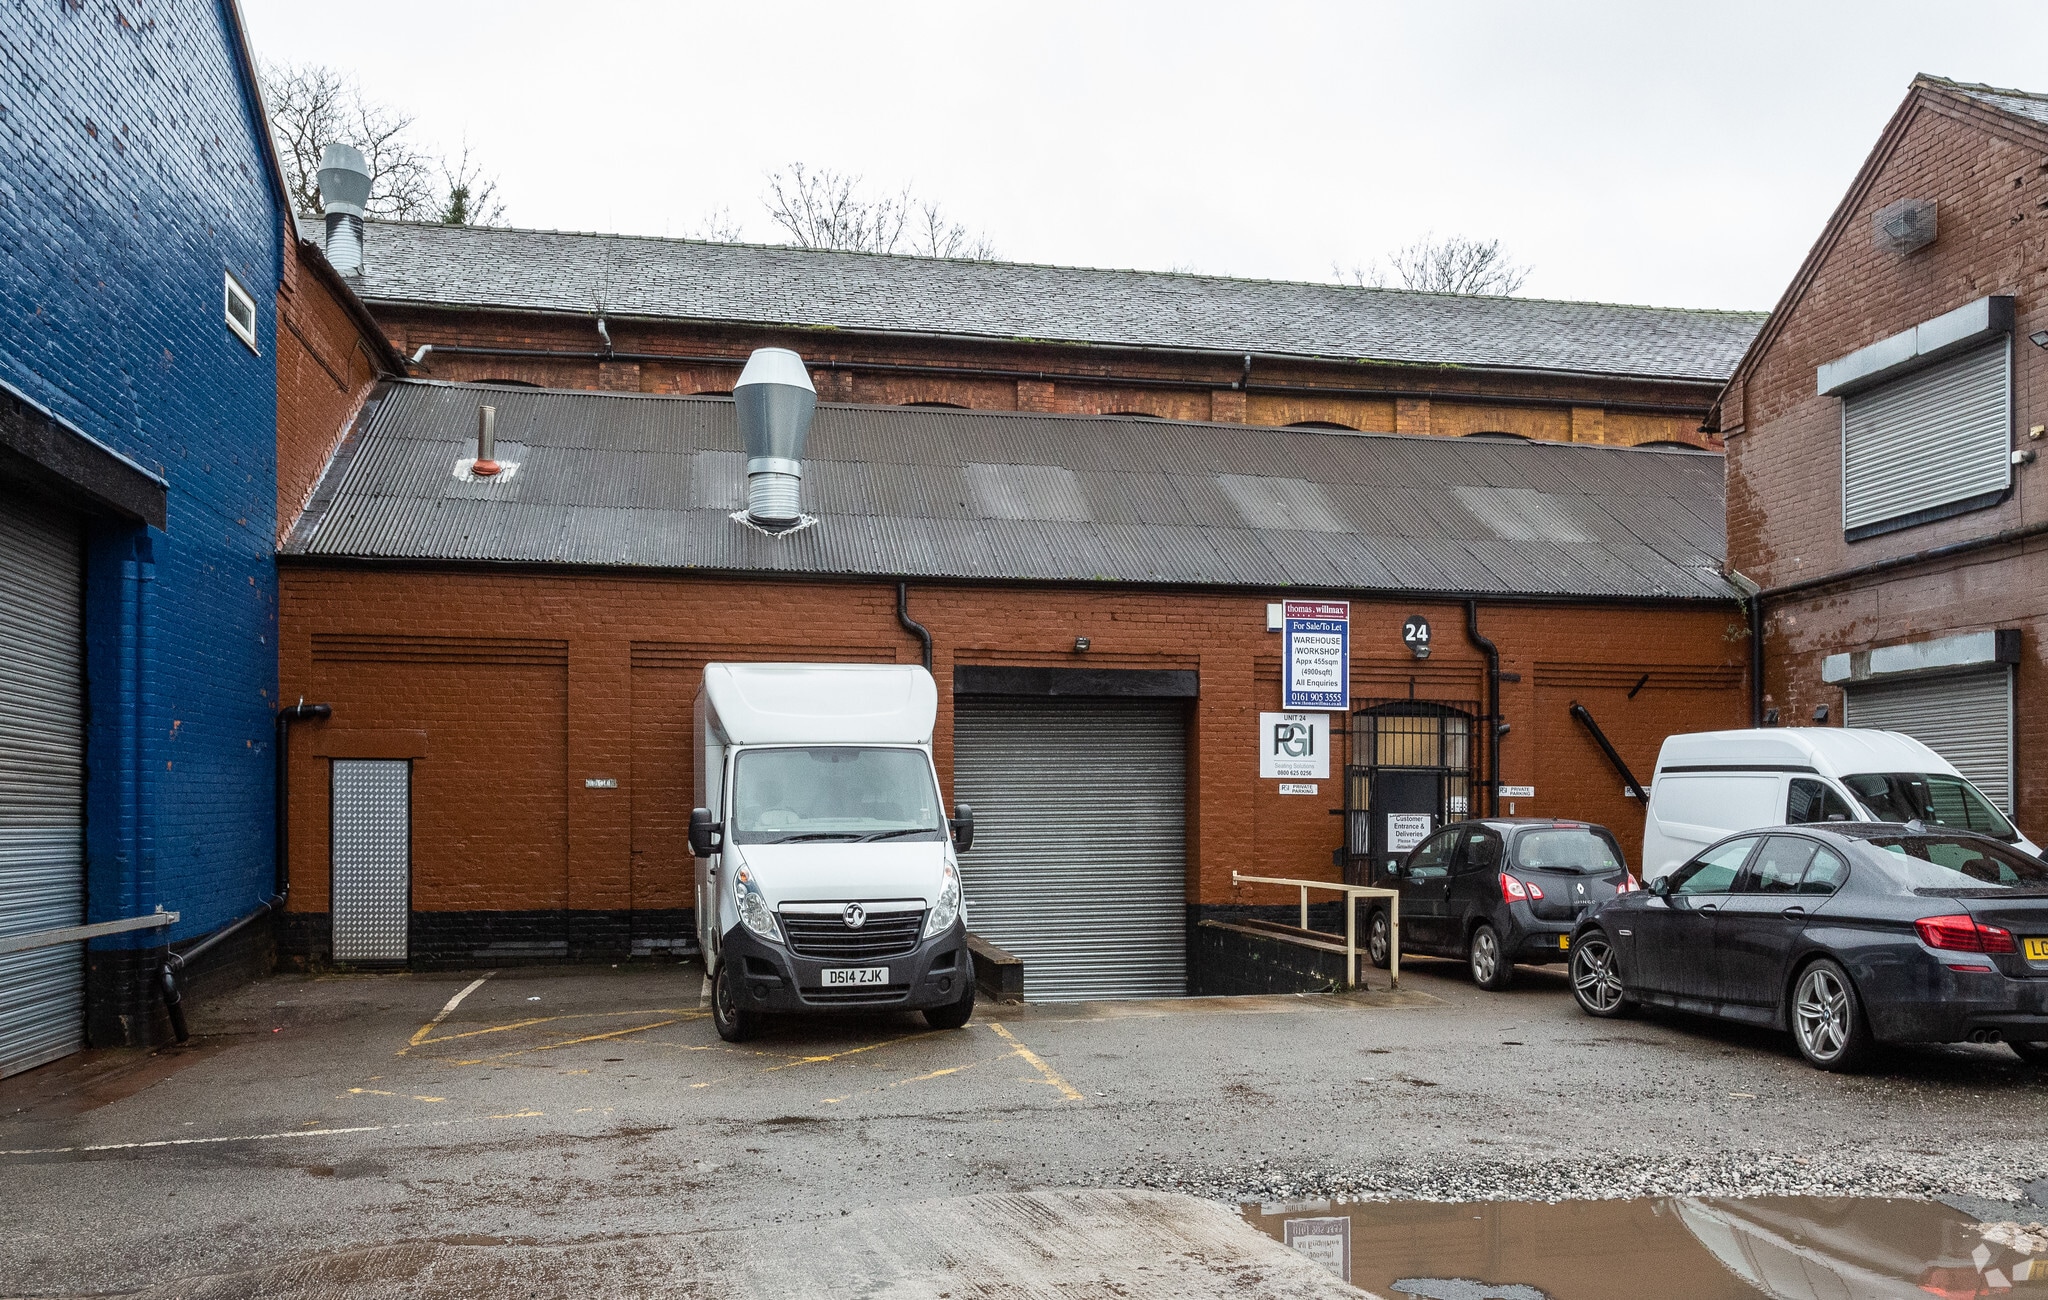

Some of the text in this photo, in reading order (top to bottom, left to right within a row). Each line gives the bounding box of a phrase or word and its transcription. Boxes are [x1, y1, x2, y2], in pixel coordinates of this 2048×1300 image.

[1315, 604, 1344, 614] willmax
[1293, 621, 1342, 631] For Sale/To Let
[1405, 623, 1429, 642] 24
[1293, 636, 1341, 645] WAREHOUSE
[1294, 647, 1340, 656] /WORKSHOP
[1296, 657, 1339, 666] Appx 455sqm
[1301, 668, 1333, 677] (4900sqft)
[1306, 679, 1339, 688] Enquiries
[1291, 692, 1342, 702] 0161 905 3555
[1274, 722, 1314, 757] PGI
[830, 969, 882, 984] DS14 ZJK
